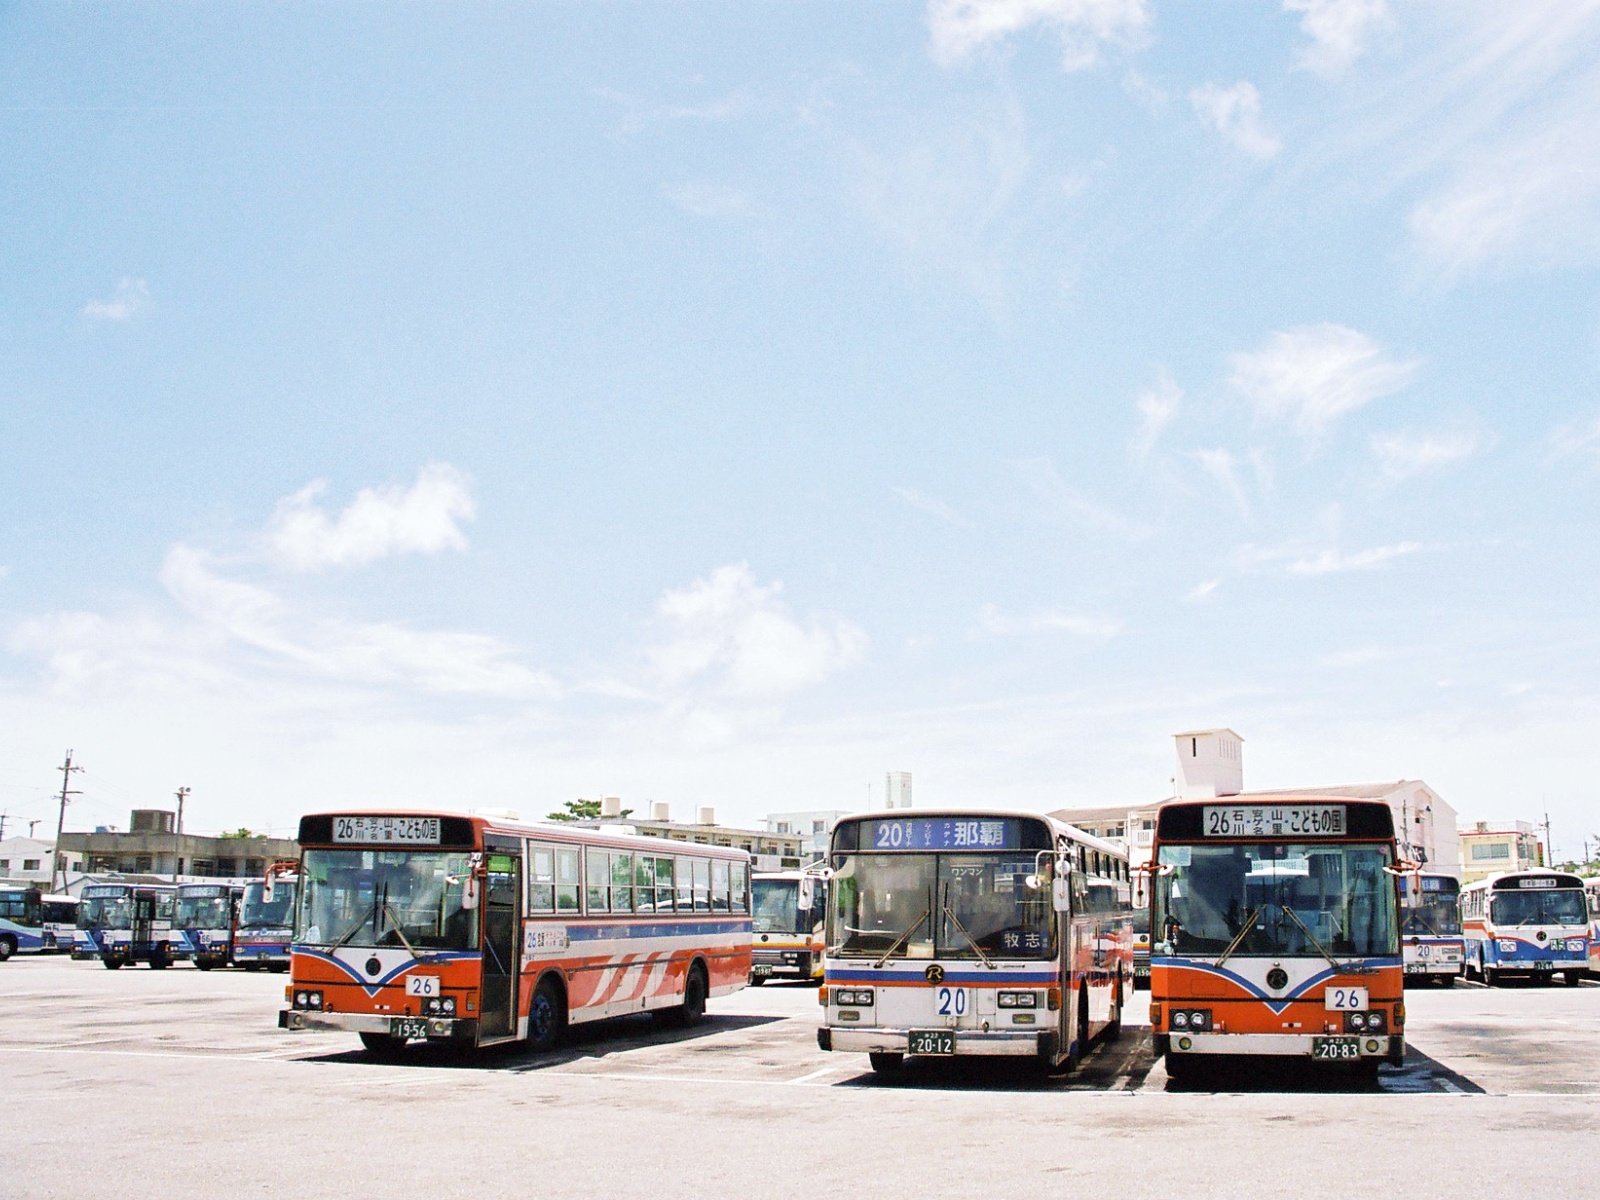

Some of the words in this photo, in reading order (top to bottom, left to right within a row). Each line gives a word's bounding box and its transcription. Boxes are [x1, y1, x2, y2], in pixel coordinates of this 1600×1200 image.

[337, 818, 353, 839] 26
[1209, 810, 1230, 834] 26
[1291, 809, 1342, 833] こどもの国
[877, 822, 903, 847] 20
[954, 821, 1005, 846] 那覇
[951, 868, 984, 877] ワンマン
[527, 932, 537, 948] 26
[1004, 933, 1041, 948] 牧志
[1417, 945, 1430, 957] 20
[413, 978, 432, 994] 26
[938, 987, 966, 1015] 20
[1335, 989, 1359, 1008] 26
[917, 1038, 952, 1053] 20-12
[1321, 1044, 1358, 1058] 20-83
